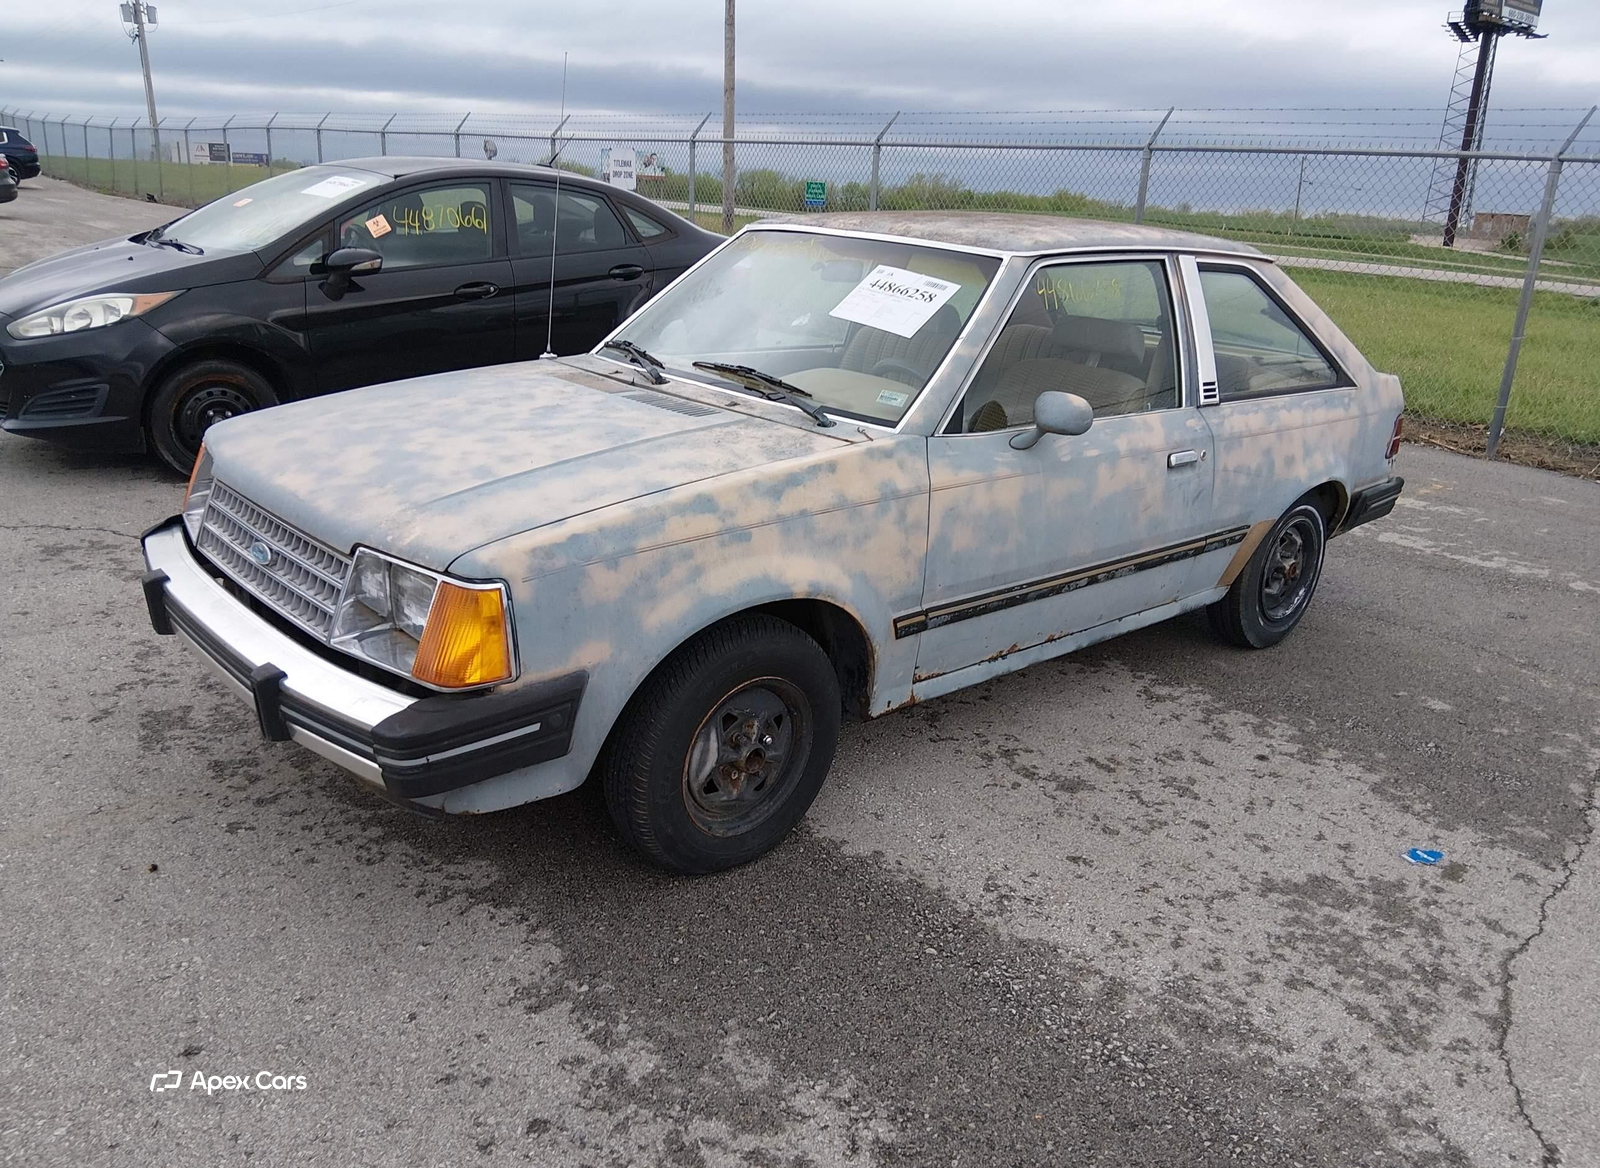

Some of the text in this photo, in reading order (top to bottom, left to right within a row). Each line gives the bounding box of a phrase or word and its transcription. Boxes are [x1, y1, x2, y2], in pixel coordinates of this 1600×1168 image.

[613, 160, 632, 168] TITLEMAX
[623, 171, 633, 179] ZONE
[869, 278, 938, 304] 44866258
